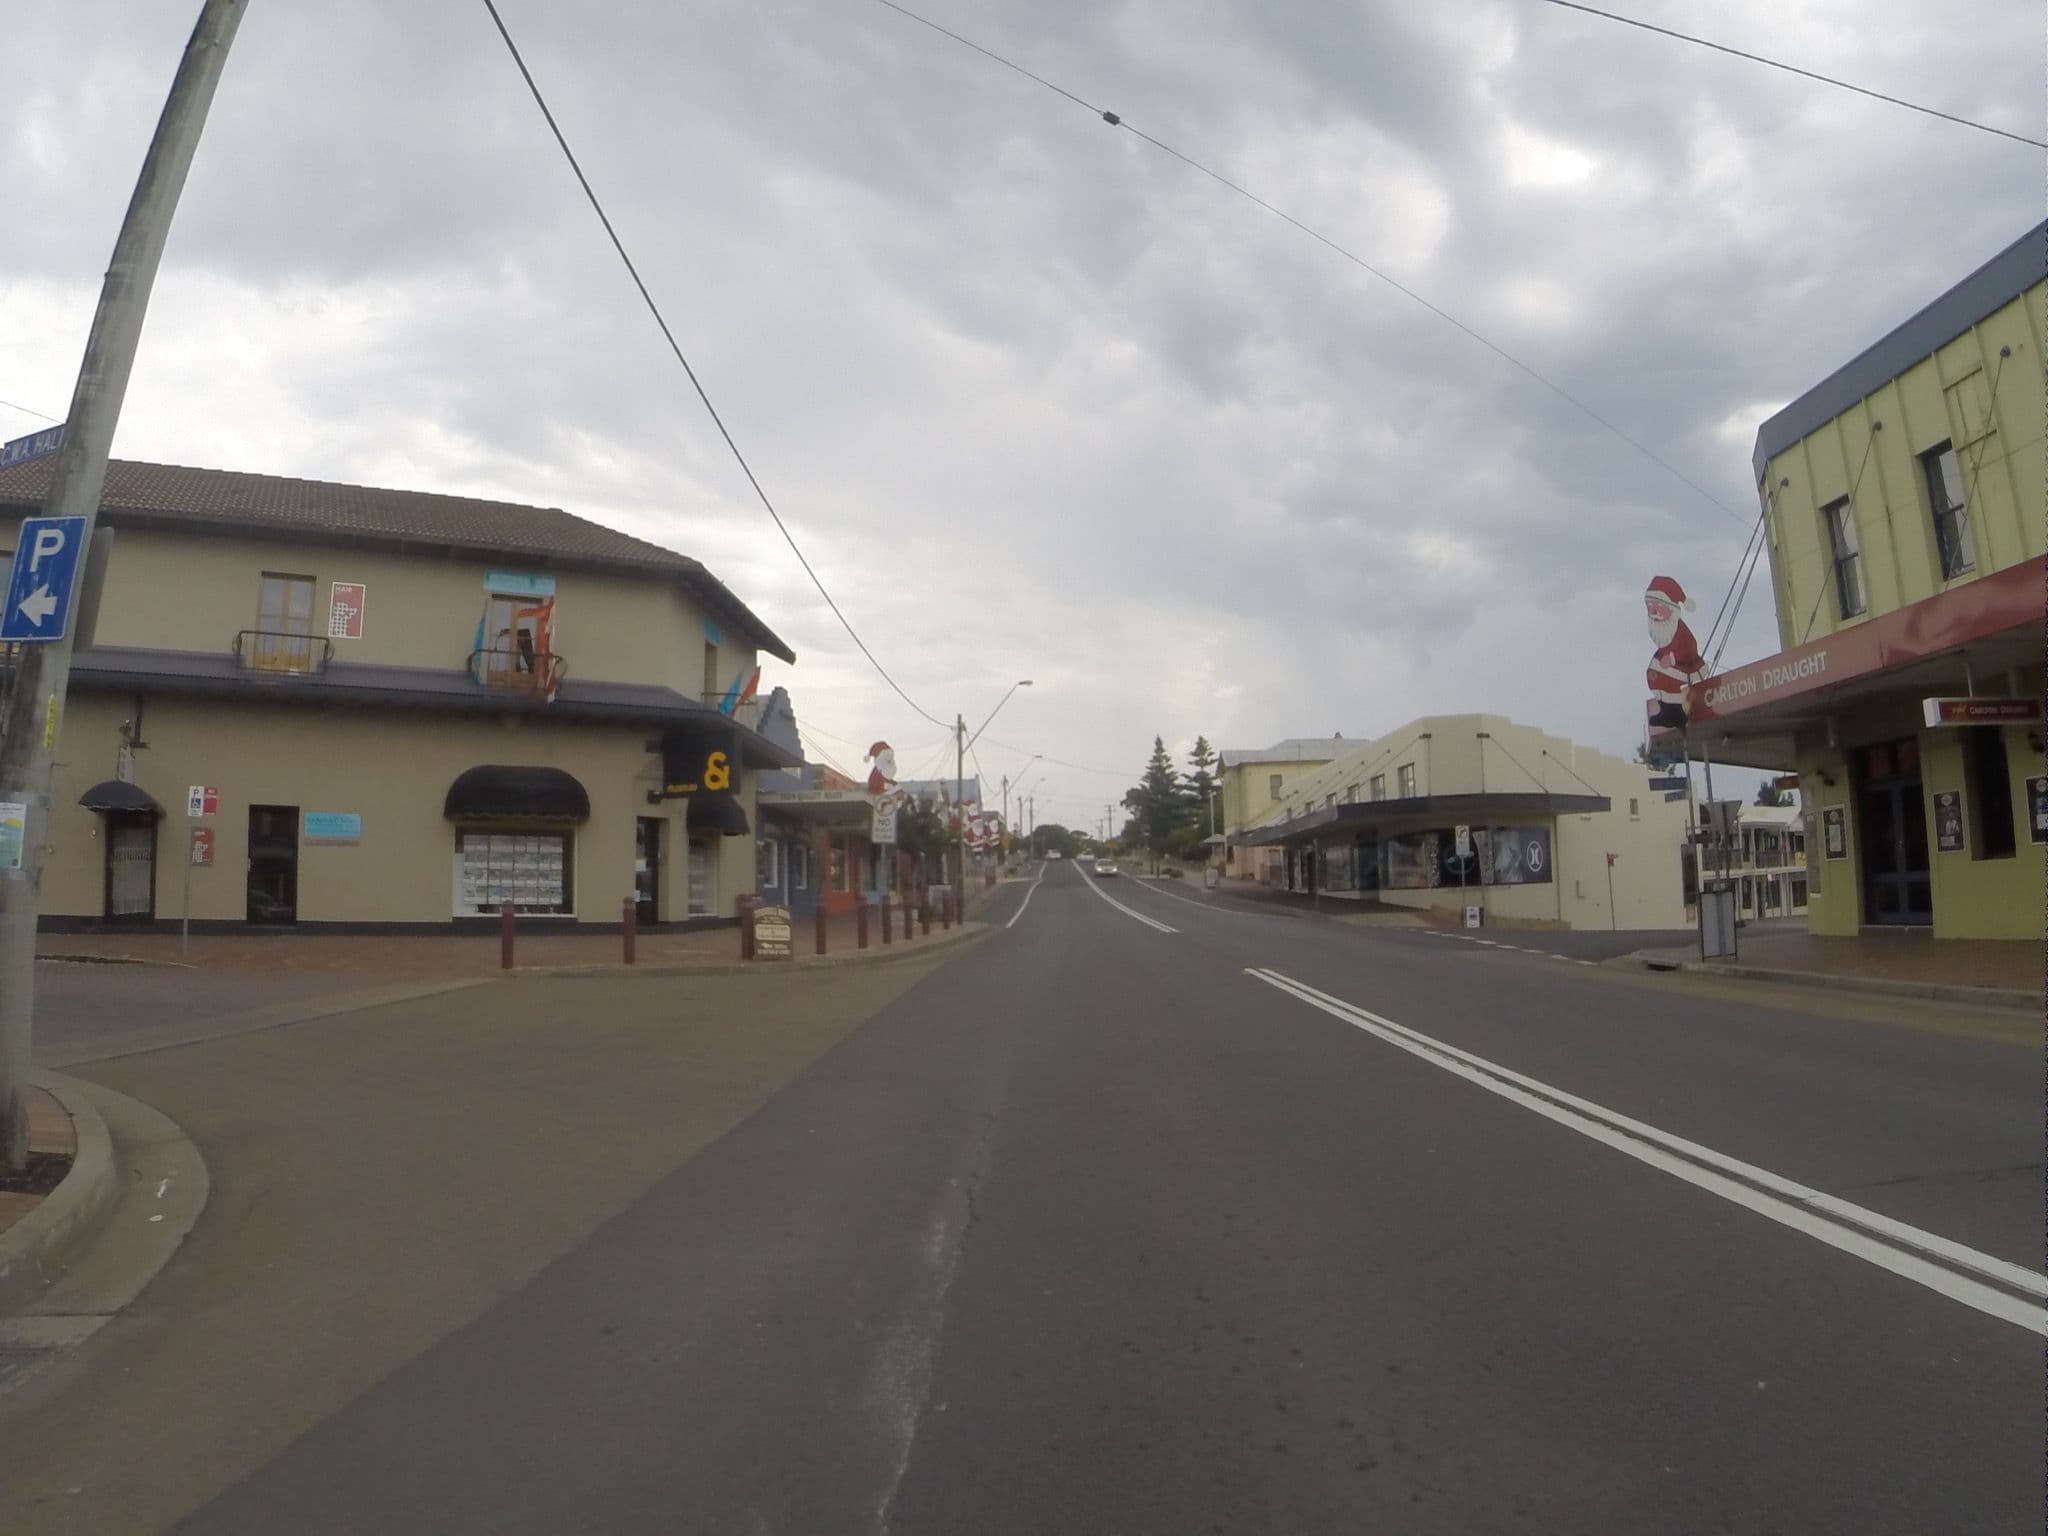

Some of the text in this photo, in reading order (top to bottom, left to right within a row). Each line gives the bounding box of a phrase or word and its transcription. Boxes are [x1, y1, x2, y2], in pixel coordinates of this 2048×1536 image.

[29, 528, 65, 573] P
[1704, 650, 1827, 708] CARLTON DRAUGHT
